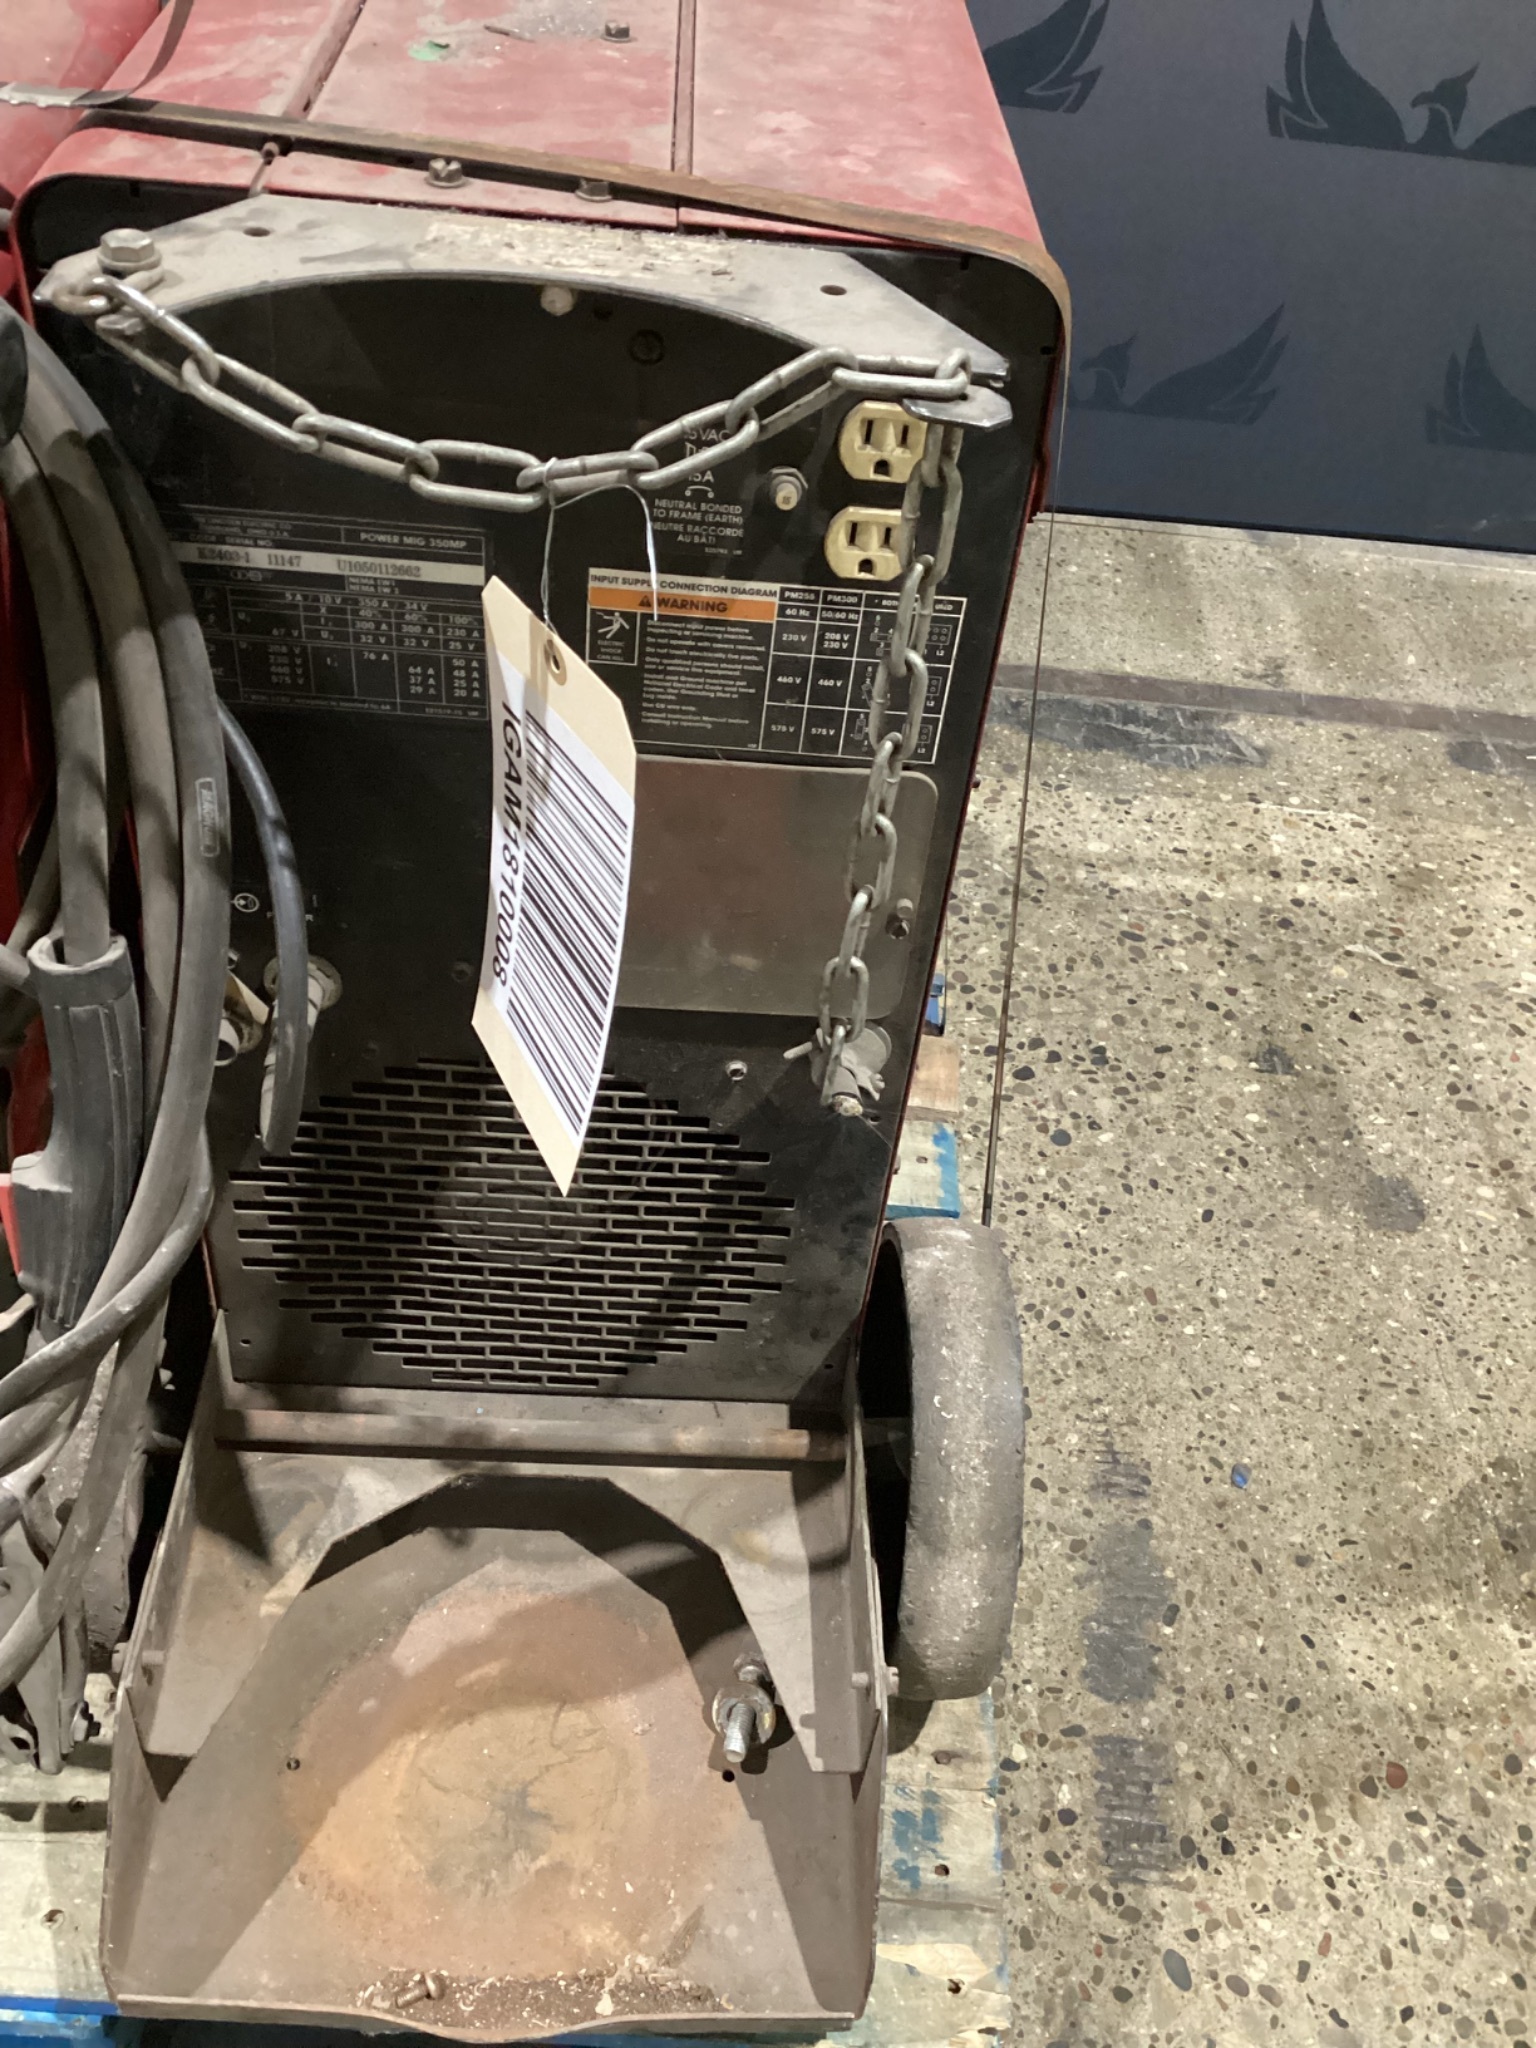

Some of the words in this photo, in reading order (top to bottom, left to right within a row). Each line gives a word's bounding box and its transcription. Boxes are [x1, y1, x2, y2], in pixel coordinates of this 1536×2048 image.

[654, 498, 697, 511] NEUTRAL
[700, 502, 743, 515] BONDED
[653, 508, 667, 519] TO
[669, 510, 702, 522] FRAME
[704, 513, 744, 526] (EARTH)
[652, 521, 685, 533] NEUTRE
[359, 531, 400, 544] POWER
[403, 535, 426, 547] MIG
[429, 538, 467, 549] 350MP
[676, 532, 691, 542] AU
[267, 553, 302, 567] 11147
[590, 574, 619, 585] INPUT
[621, 577, 656, 588] SUPPL
[659, 580, 728, 595] CONNECTION
[730, 587, 778, 598] DIAGRAM
[784, 591, 815, 600] PM255
[826, 594, 858, 604] PM300
[358, 598, 379, 607] 350
[381, 600, 389, 608] A
[420, 603, 428, 611] V
[656, 597, 729, 613] WARNING
[785, 608, 798, 616] 60
[799, 609, 811, 617] Hz
[821, 610, 847, 620] 50/60
[848, 612, 859, 621] Hz
[380, 623, 389, 631] A
[426, 626, 435, 635] A
[447, 628, 467, 637] 230
[472, 630, 480, 638] A
[824, 632, 839, 641] 208
[840, 633, 850, 641] V
[360, 634, 374, 643] 32
[378, 636, 387, 645] V
[403, 638, 417, 647] 32
[421, 639, 430, 648] V
[448, 641, 462, 650] 25
[467, 643, 476, 651] V
[782, 633, 797, 641] 230
[798, 634, 807, 642] V
[823, 641, 838, 649] 230
[839, 642, 849, 650] V
[381, 653, 389, 661] A
[452, 658, 466, 667] 50
[471, 660, 479, 668] A
[408, 665, 422, 674] 64
[427, 667, 435, 675] A
[452, 669, 466, 677] 48
[471, 670, 480, 678] A
[409, 675, 422, 684] 37
[428, 677, 436, 685] A
[453, 679, 467, 688] 25
[472, 681, 480, 689] A
[776, 676, 793, 684] 460
[793, 677, 802, 685] V
[817, 678, 834, 686] 460
[834, 680, 843, 688] V
[409, 685, 423, 694] 29
[428, 687, 437, 695] A
[453, 689, 468, 697] 20
[472, 690, 480, 698] A
[771, 725, 786, 733] 575
[786, 726, 795, 734] V
[811, 728, 826, 736] 575
